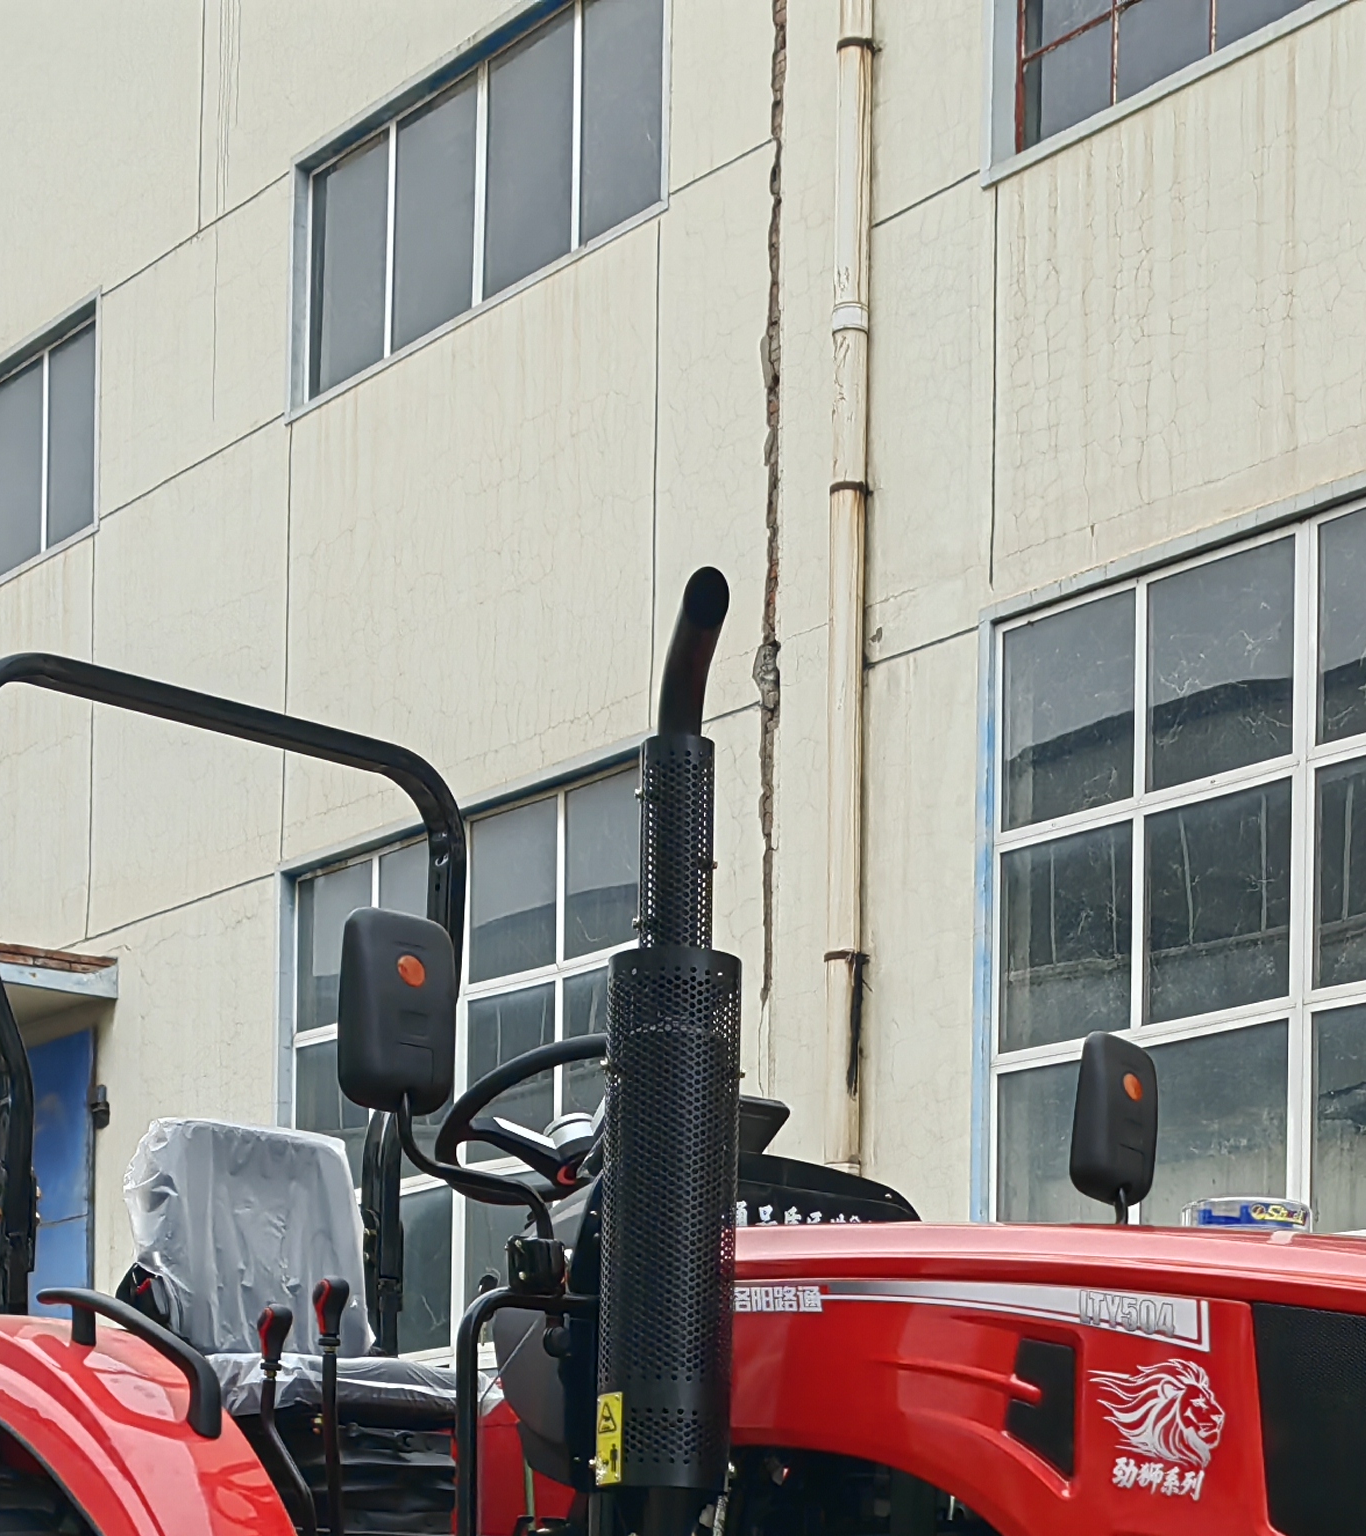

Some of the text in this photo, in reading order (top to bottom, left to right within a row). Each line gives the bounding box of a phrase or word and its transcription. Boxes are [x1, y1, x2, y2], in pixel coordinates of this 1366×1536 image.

[1079, 1289, 1176, 1339] LTY504
[1111, 1456, 1205, 1502] 劲狮系列
